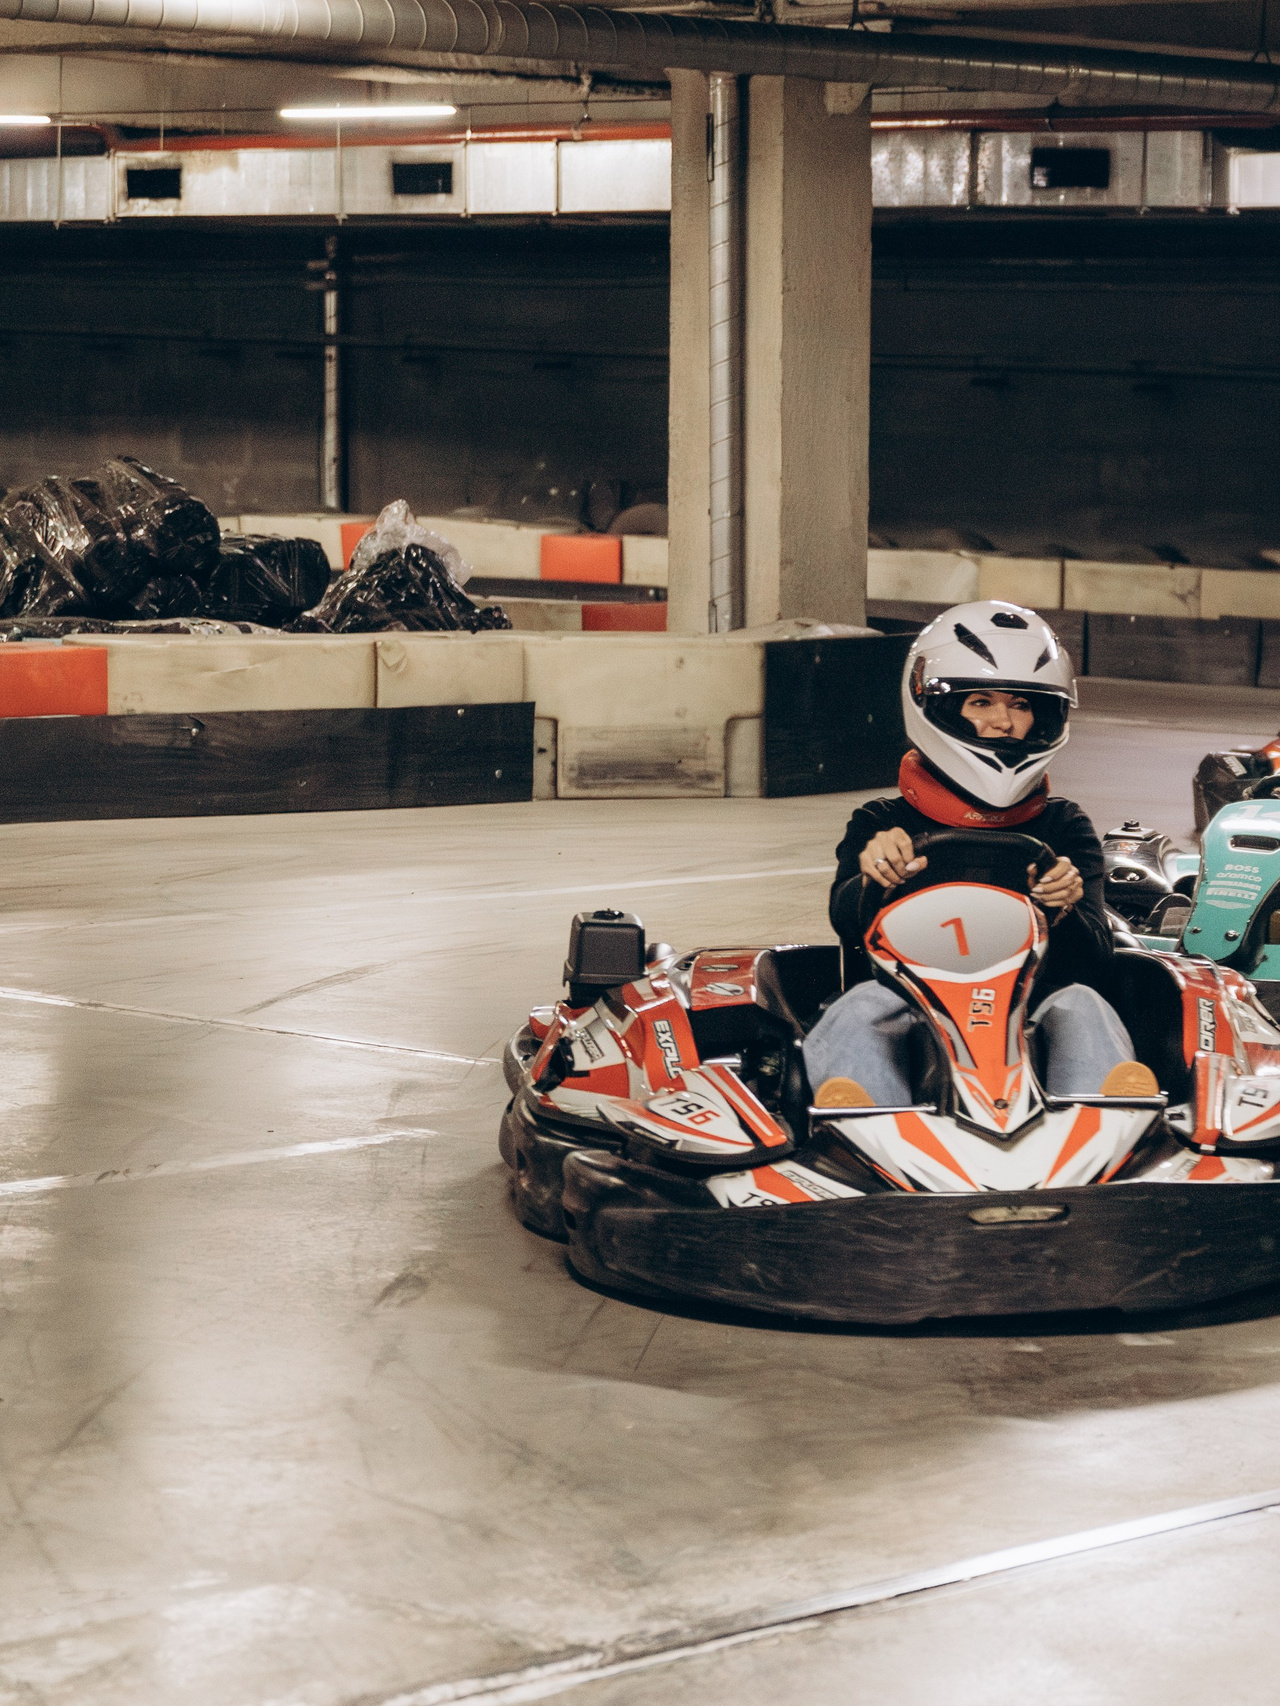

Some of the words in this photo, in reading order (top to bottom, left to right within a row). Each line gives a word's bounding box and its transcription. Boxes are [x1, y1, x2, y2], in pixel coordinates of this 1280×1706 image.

[1216, 872, 1263, 882] aramco
[1224, 863, 1260, 874] BOSS
[1206, 887, 1259, 900] PIRELLI
[939, 917, 970, 957] 1
[967, 988, 997, 1033] TS6
[658, 1097, 722, 1126] TS6
